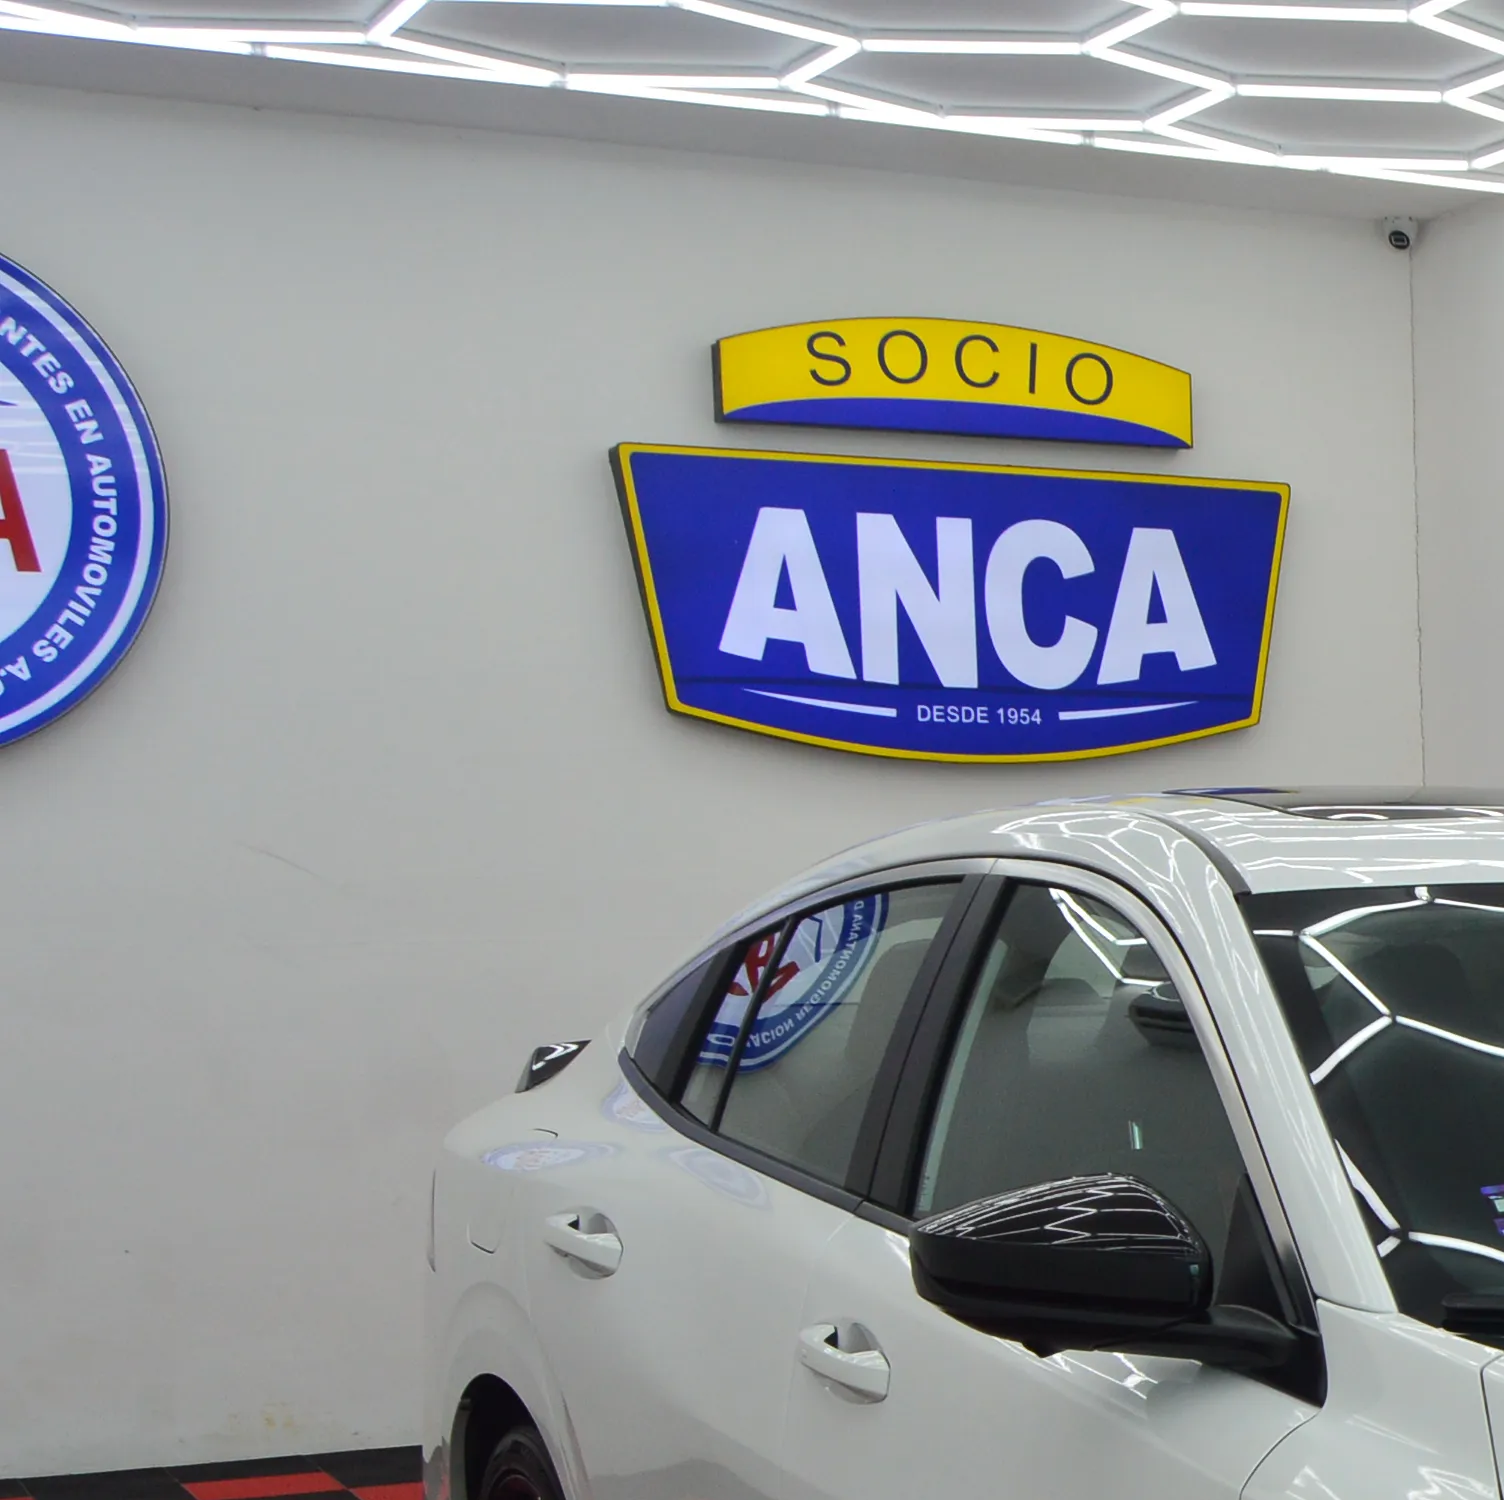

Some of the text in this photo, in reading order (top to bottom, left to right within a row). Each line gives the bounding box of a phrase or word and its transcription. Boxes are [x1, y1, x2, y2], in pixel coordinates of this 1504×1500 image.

[0, 316, 74, 395] NTES
[804, 330, 1113, 406] SOCIO
[64, 399, 104, 445] EN
[32, 453, 117, 663] AUTOMOVILES
[718, 506, 1218, 690] ANCA
[0, 656, 32, 696] A.
[917, 705, 1042, 725] DESDE 1954
